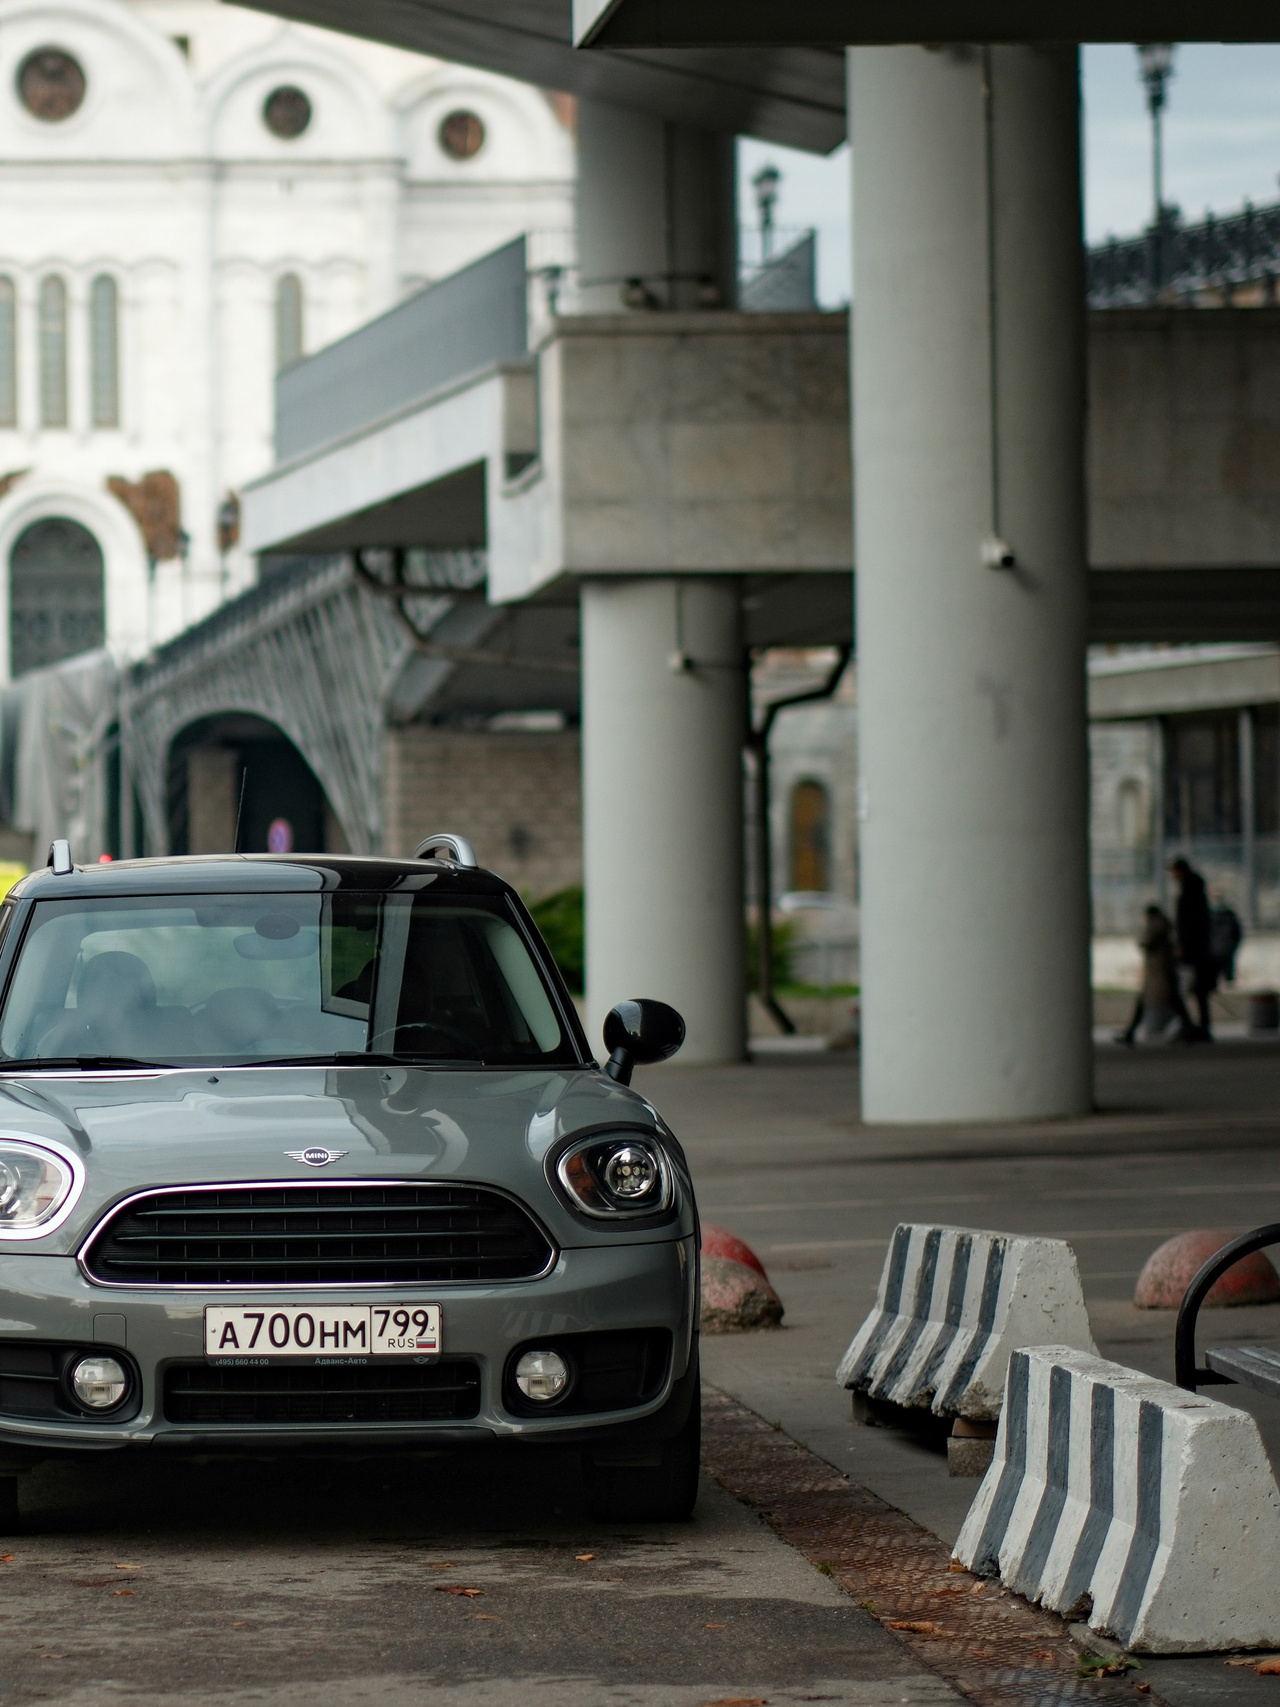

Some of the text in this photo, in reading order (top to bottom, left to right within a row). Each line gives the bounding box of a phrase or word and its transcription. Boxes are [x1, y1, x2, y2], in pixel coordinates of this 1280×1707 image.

[374, 1309, 430, 1337] 799
[387, 1338, 415, 1348] RUS
[215, 1358, 234, 1366] (495)
[315, 1357, 367, 1366] Адванс-Авто
